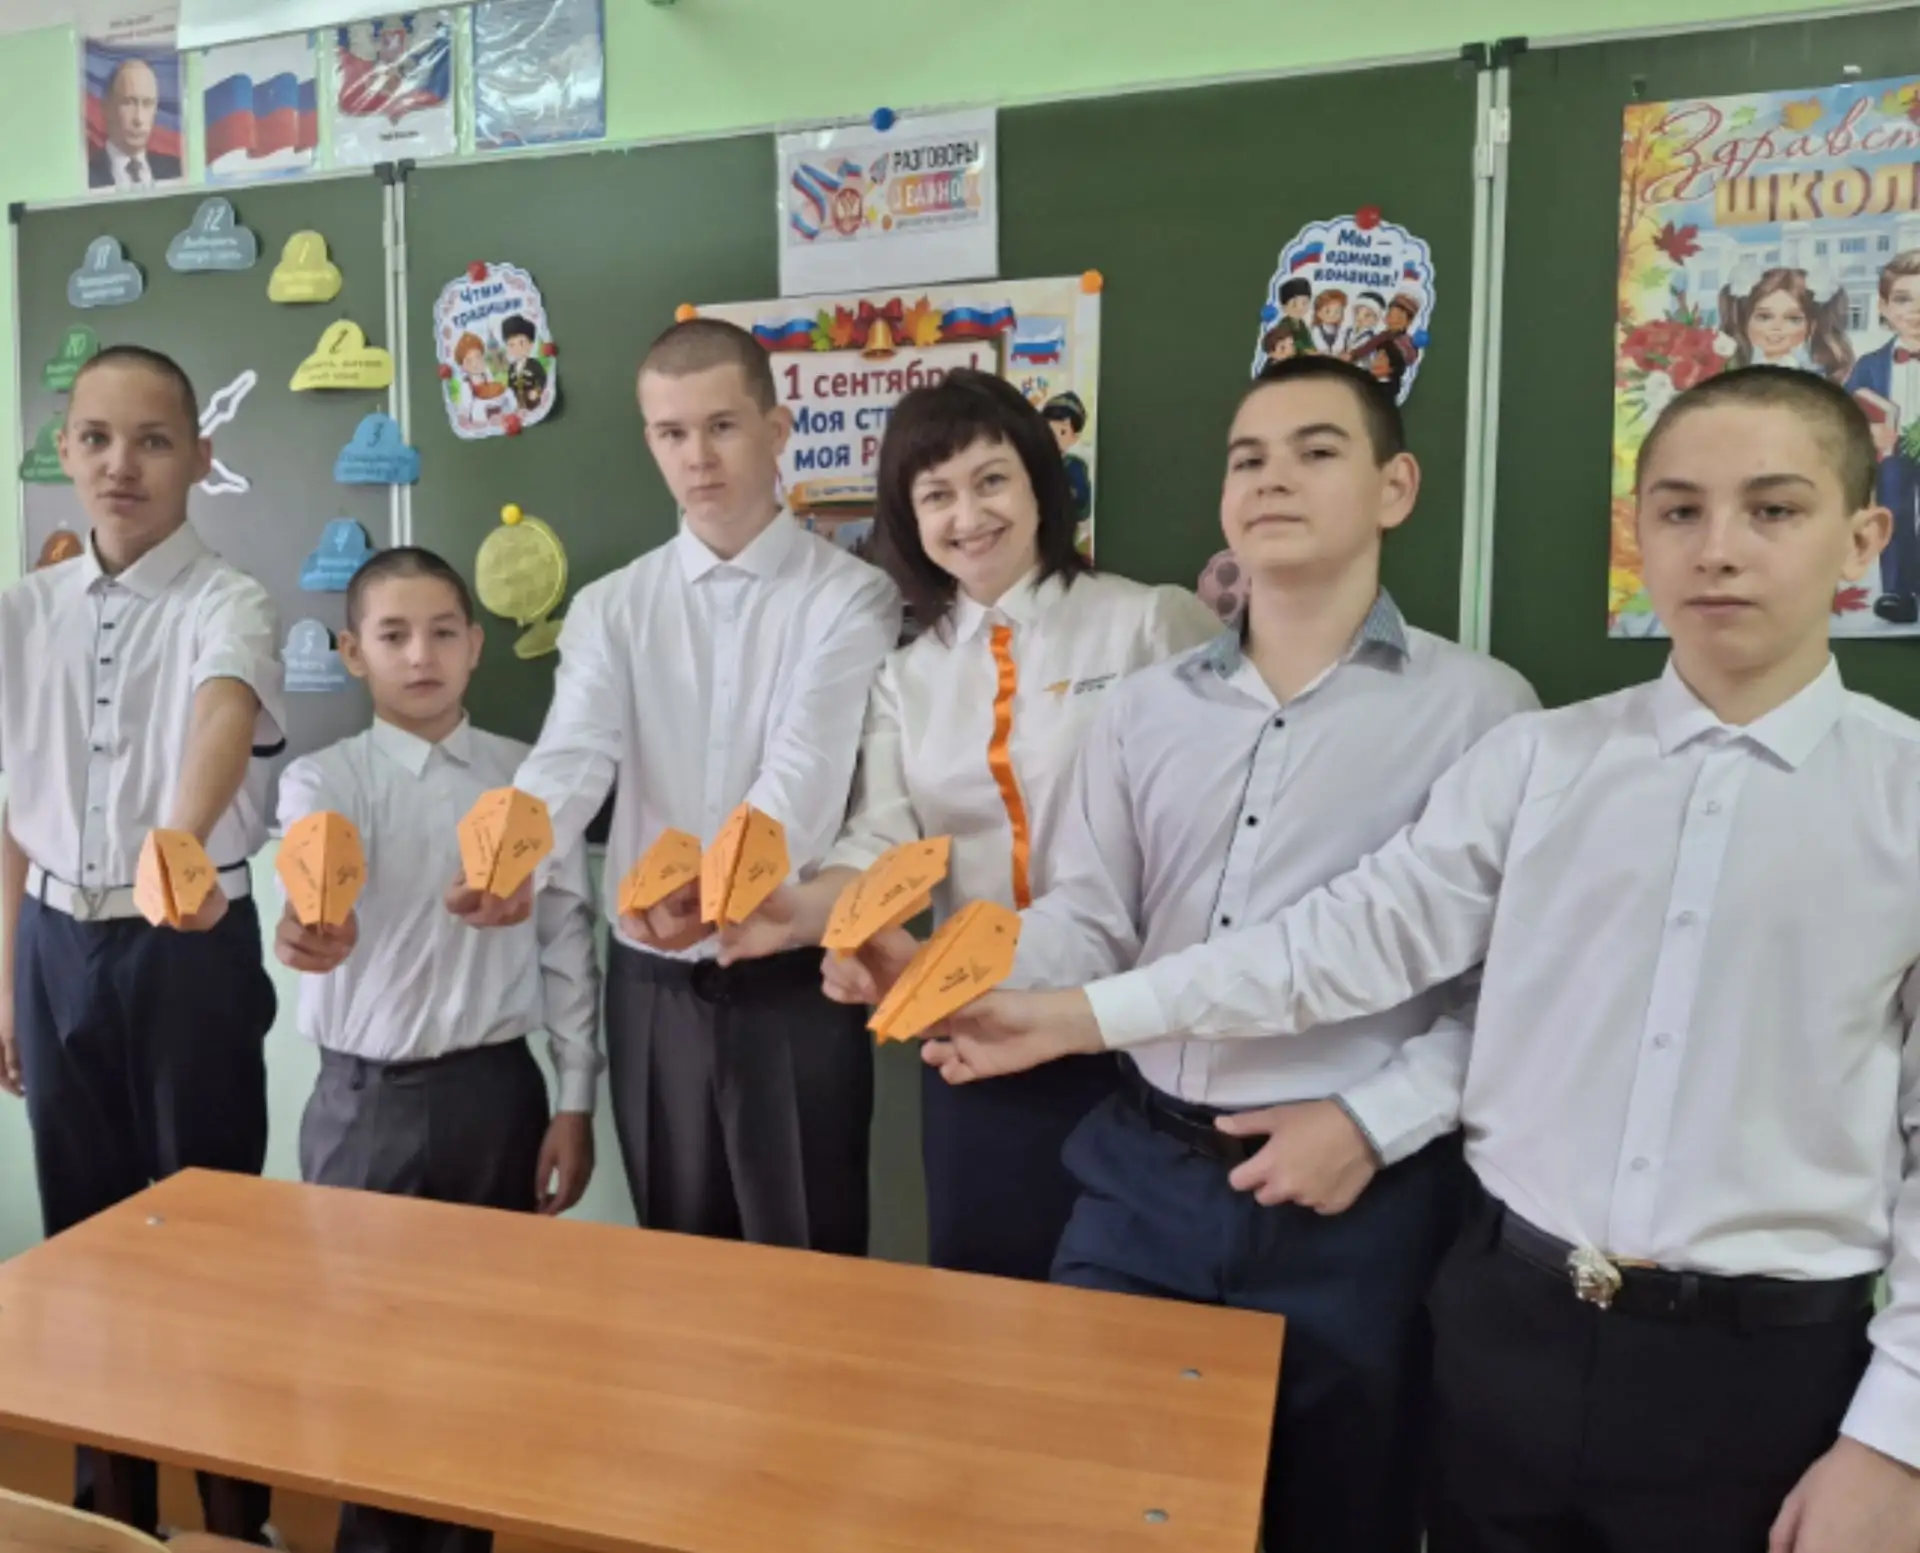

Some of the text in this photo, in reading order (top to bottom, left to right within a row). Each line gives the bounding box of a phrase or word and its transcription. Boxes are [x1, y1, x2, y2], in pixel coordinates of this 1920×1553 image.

[893, 141, 979, 173] РАЗГОВОРЫ
[203, 206, 226, 231] 12
[1337, 229, 1371, 248] Мы
[299, 240, 309, 264] 1
[1325, 250, 1392, 267] единая
[1314, 269, 1399, 287] команда!
[460, 282, 503, 304] Чтим
[784, 352, 979, 401] 1 сентябр!
[794, 443, 850, 471] моя
